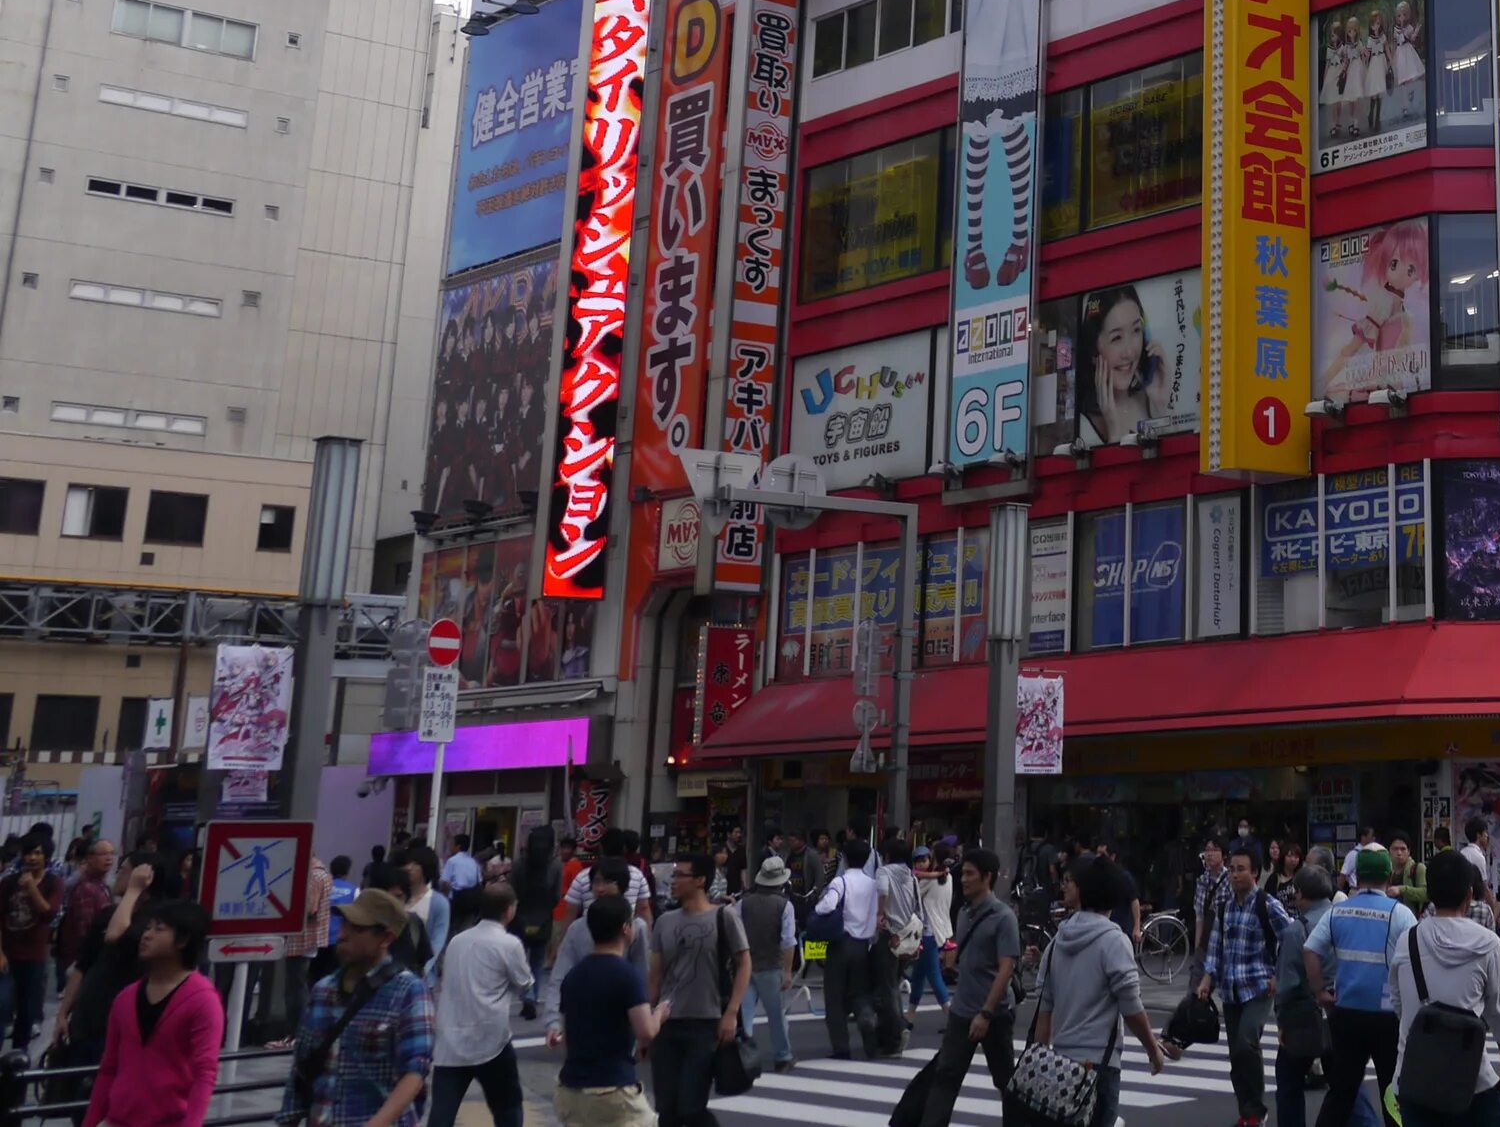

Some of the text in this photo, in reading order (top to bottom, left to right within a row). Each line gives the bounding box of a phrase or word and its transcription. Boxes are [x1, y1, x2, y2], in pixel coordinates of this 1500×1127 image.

[754, 10, 796, 119] 買取り
[1320, 149, 1340, 168] 6F
[648, 83, 714, 452] 買います。
[741, 168, 780, 293] まっくす
[1320, 234, 1370, 263] azone
[956, 306, 1029, 355] azone
[1253, 235, 1290, 380] 秋葉原
[801, 364, 925, 415] UCHUSEN
[825, 404, 893, 447] 宇宙船
[955, 380, 1025, 457] 6F
[724, 344, 772, 562] アキバ前店
[813, 441, 900, 466] TOYS & FIGURES
[1274, 493, 1420, 532] KAYODO
[1211, 528, 1222, 626] Cogent DataHub
[731, 632, 751, 708] ラーメン
